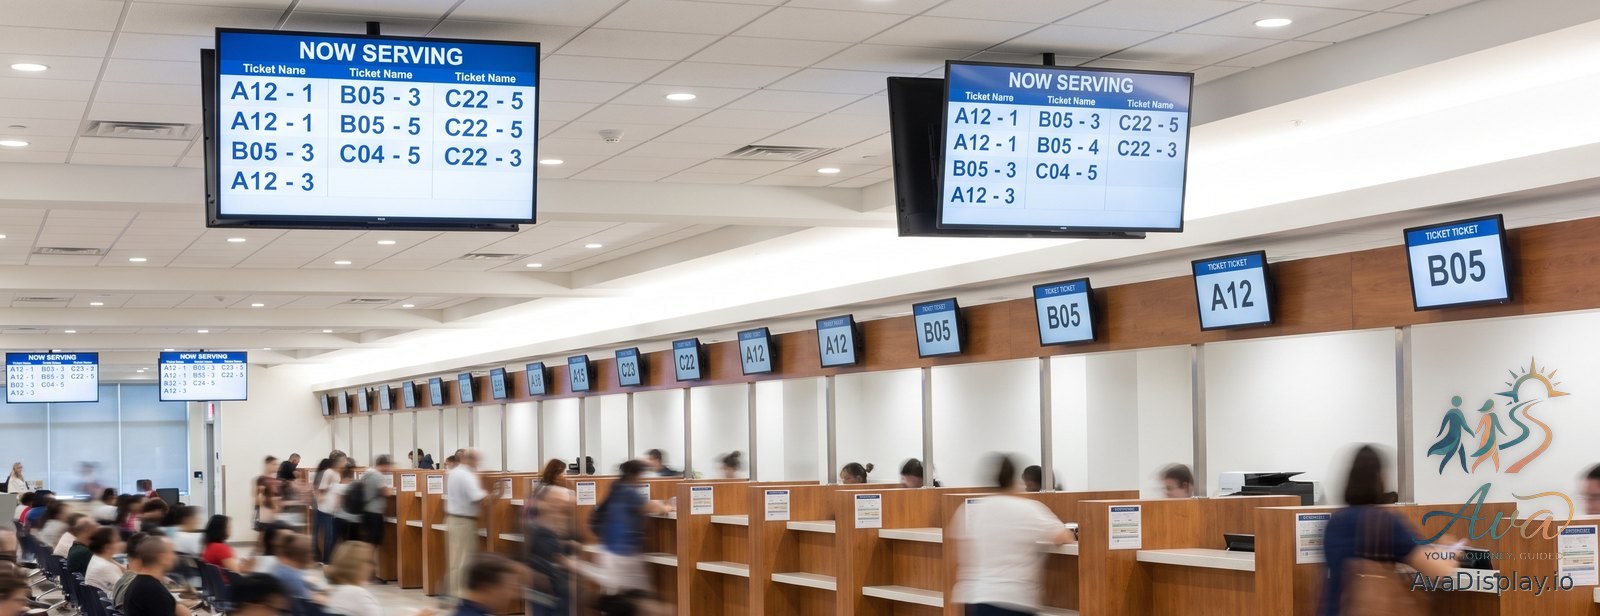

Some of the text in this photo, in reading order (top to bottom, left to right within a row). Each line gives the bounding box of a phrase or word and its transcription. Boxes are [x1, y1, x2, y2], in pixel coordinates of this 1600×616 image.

[300, 41, 463, 65] NOW SERVING
[243, 63, 276, 73] Ticket
[349, 68, 413, 79] Ticket Name
[455, 72, 516, 83] Ticket Name
[231, 81, 277, 101] A12
[302, 84, 312, 102] 1
[1009, 72, 1133, 93] NOW SERVING
[340, 85, 384, 105] B05
[408, 88, 421, 106] 3
[445, 89, 489, 108] C22
[511, 91, 523, 110] 5
[965, 91, 990, 100] Ticket
[1047, 95, 1096, 106] Ticket Name
[1127, 99, 1174, 109] Ticket Name
[231, 111, 277, 131] A12
[302, 113, 312, 132] 1
[340, 115, 384, 134] B05
[408, 117, 420, 135] 5
[955, 107, 991, 125] A12
[1010, 110, 1017, 126] 1
[1039, 111, 1073, 129] B05
[1091, 113, 1100, 130] 3
[1119, 115, 1151, 131] C22
[1169, 117, 1178, 133] 5
[445, 118, 488, 137] C22
[510, 120, 523, 138] 5
[232, 142, 277, 161] B05
[301, 143, 314, 162] 3
[953, 133, 989, 151] A12
[1009, 136, 1016, 152] 1
[1037, 137, 1071, 153] B05
[1089, 139, 1099, 155] 4
[1117, 140, 1150, 157] C22
[1168, 142, 1177, 158] 3
[340, 144, 384, 164] C04
[408, 146, 420, 164] 5
[444, 147, 487, 166] C22
[510, 149, 521, 167] 3
[953, 160, 988, 177] B05
[1007, 161, 1016, 178] 3
[1036, 163, 1070, 180] C04
[1088, 165, 1097, 180] 5
[231, 171, 277, 190] A12
[301, 173, 314, 191] 3
[951, 186, 986, 203] A12
[1005, 188, 1015, 204] 3
[1425, 225, 1478, 240] TICKET TICKET
[1208, 259, 1247, 271] TICKET TICKET
[1428, 249, 1486, 287] B05
[1045, 287, 1059, 295] TICKET
[1211, 280, 1254, 311] A12
[1047, 303, 1080, 329] B05
[923, 320, 951, 343] B05
[826, 334, 848, 355] A12
[679, 354, 695, 370] C22
[746, 345, 764, 364] A12
[573, 368, 585, 383] A15
[621, 361, 635, 377] C23
